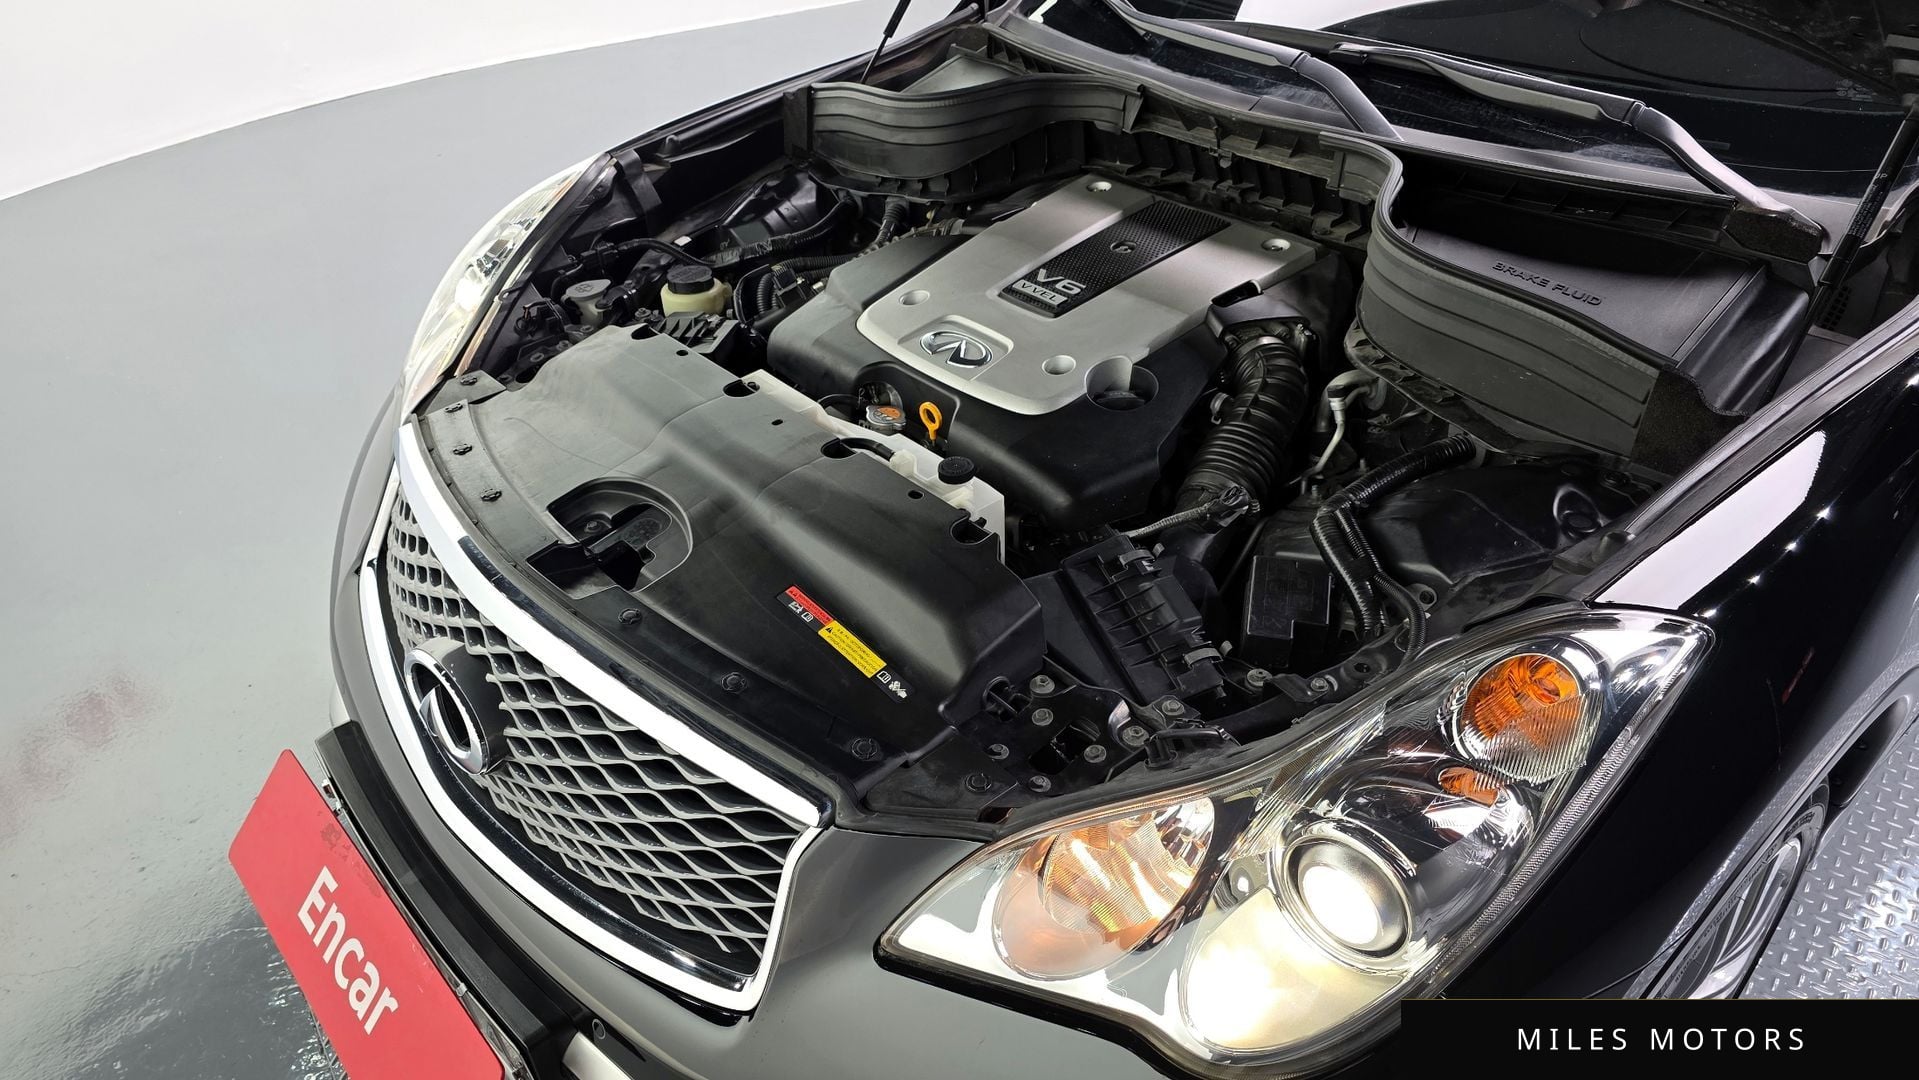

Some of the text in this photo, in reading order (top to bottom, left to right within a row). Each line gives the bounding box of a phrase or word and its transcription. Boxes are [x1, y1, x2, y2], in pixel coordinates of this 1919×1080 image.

[1019, 281, 1059, 302] VVEL
[1037, 268, 1086, 295] V6
[1492, 262, 1603, 306] BRAKE FLUID
[297, 865, 399, 1035] Encar
